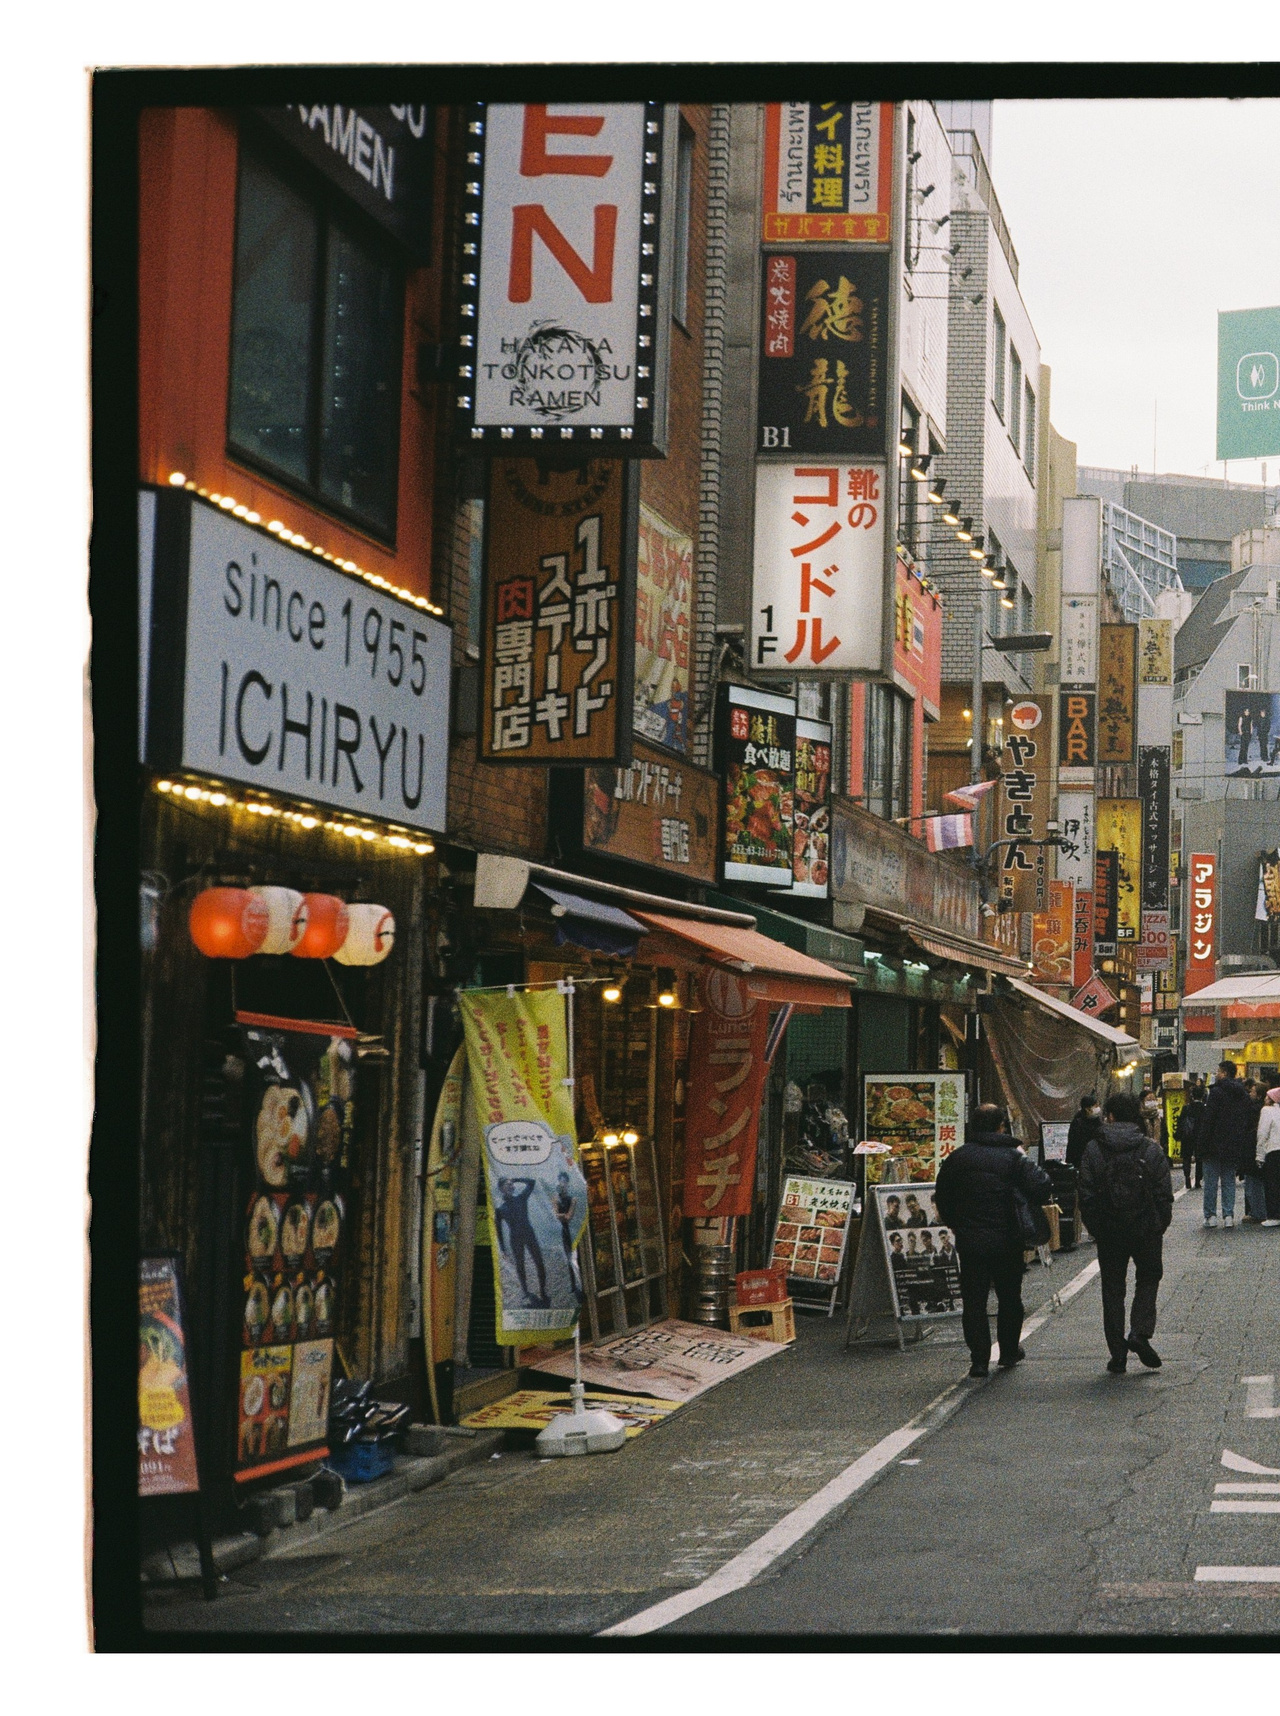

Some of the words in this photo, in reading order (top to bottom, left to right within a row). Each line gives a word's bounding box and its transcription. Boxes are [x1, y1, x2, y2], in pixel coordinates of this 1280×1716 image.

[287, 103, 396, 200] AMEN
[812, 101, 845, 207] イ料理
[500, 335, 612, 356] HAKATA
[768, 259, 792, 353] 炭火焼肉
[483, 363, 631, 382] TONKOTSU
[510, 390, 601, 408] RAMEN
[1241, 401, 1270, 412] Think
[762, 426, 792, 448] B1
[847, 468, 880, 530] 靴の
[783, 467, 843, 665] コンドル
[224, 552, 326, 651] since
[341, 598, 428, 697] 1955
[534, 554, 573, 739] ステーキ
[573, 514, 618, 736] 1ポンド
[219, 660, 425, 811] ICHIRYU
[744, 742, 791, 771] 食べ放題
[1067, 697, 1089, 761] BAR
[1002, 734, 1038, 871] やきとん
[1143, 915, 1168, 924] IZZA
[1193, 863, 1214, 961] アラジン
[697, 1038, 753, 1211] ランチ
